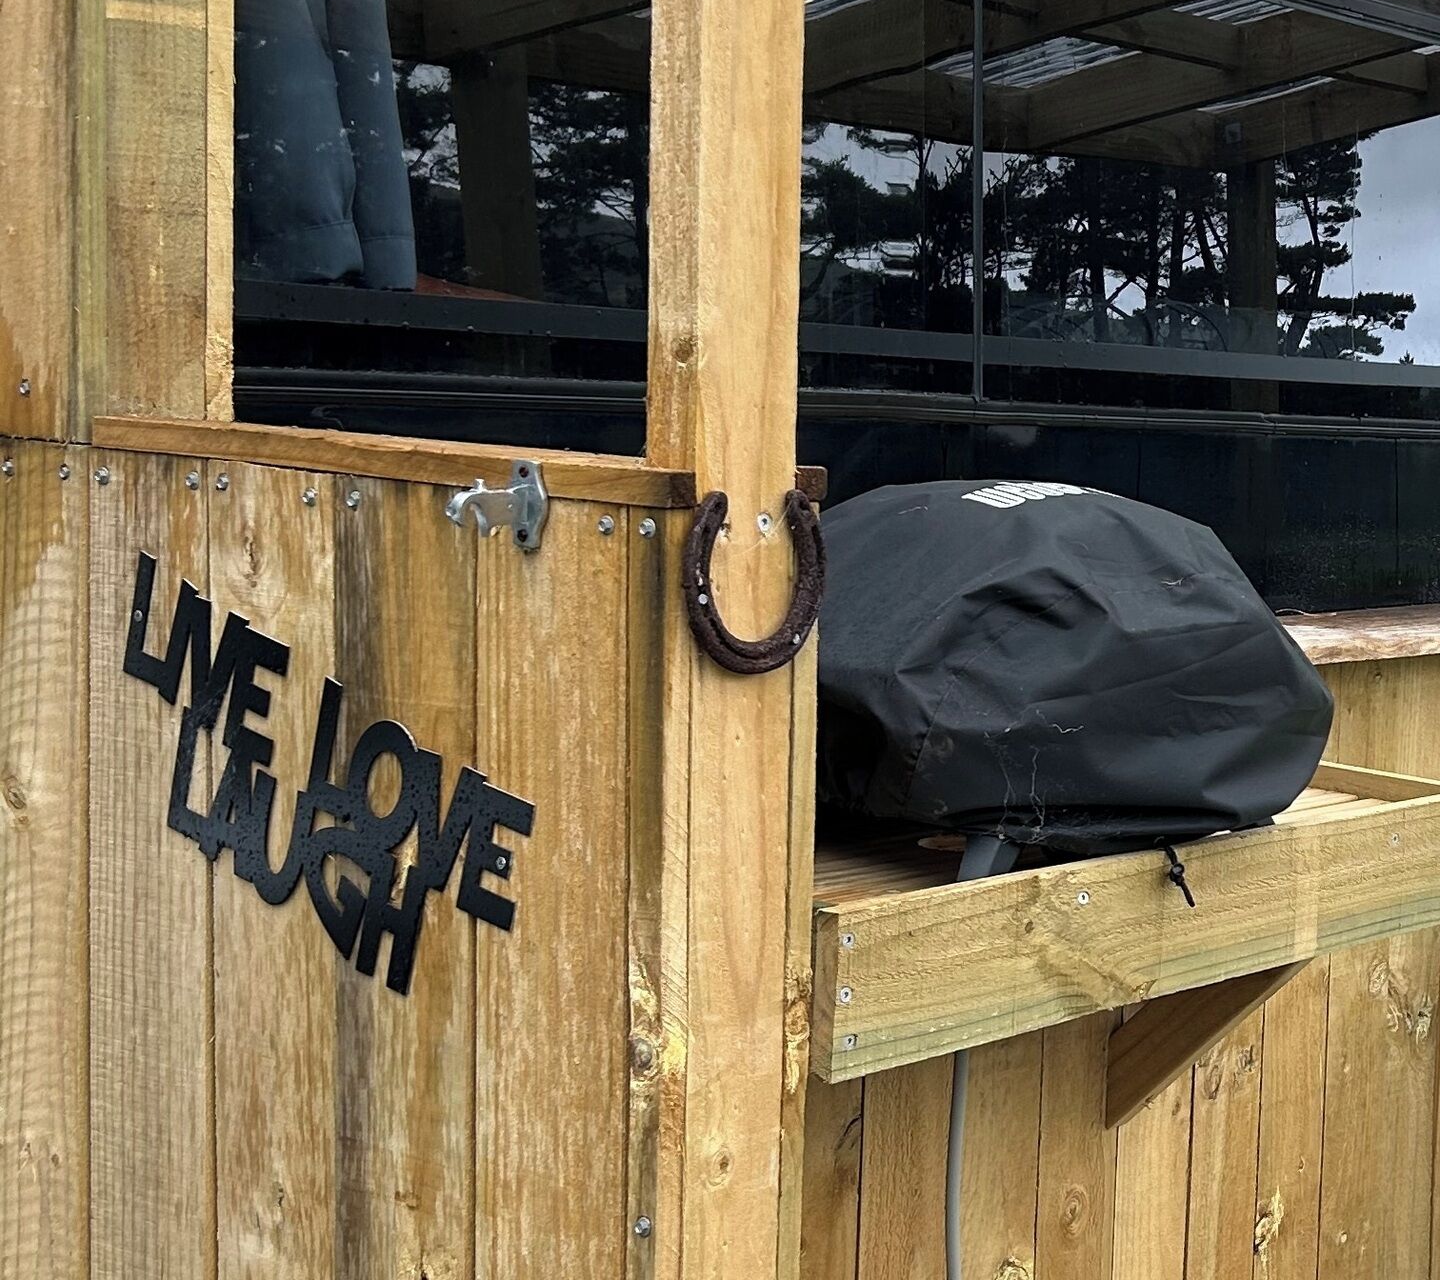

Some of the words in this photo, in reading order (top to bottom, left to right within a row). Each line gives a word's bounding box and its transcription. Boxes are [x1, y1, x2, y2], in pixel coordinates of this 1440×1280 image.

[961, 481, 1120, 509] webe
[123, 551, 290, 767] LIVE
[304, 676, 536, 932] LOVE
[168, 707, 429, 996] LAUGH
